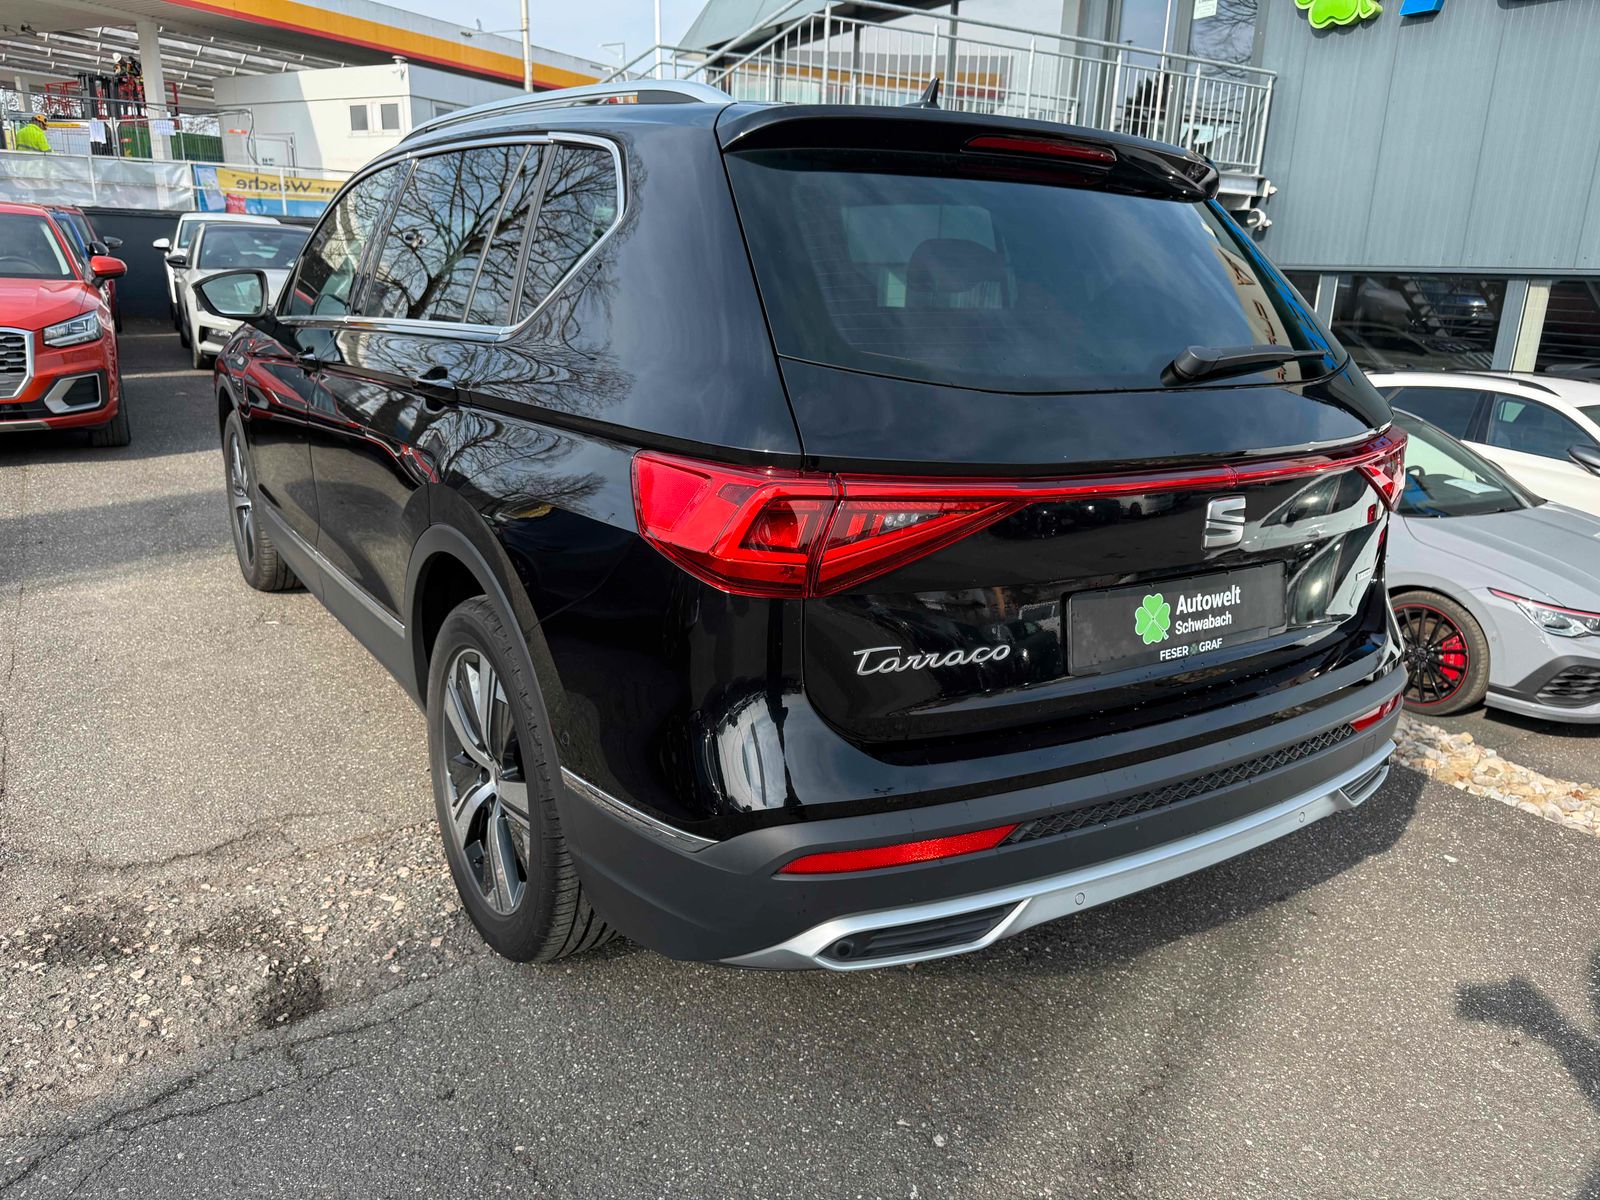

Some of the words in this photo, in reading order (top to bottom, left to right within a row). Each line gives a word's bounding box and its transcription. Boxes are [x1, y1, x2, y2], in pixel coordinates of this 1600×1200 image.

[1175, 584, 1241, 615] Autowelt
[1174, 610, 1232, 635] Schwabach
[853, 644, 1011, 676] Tarraco
[1159, 645, 1189, 661] FESER
[1198, 637, 1223, 653] GRAF
